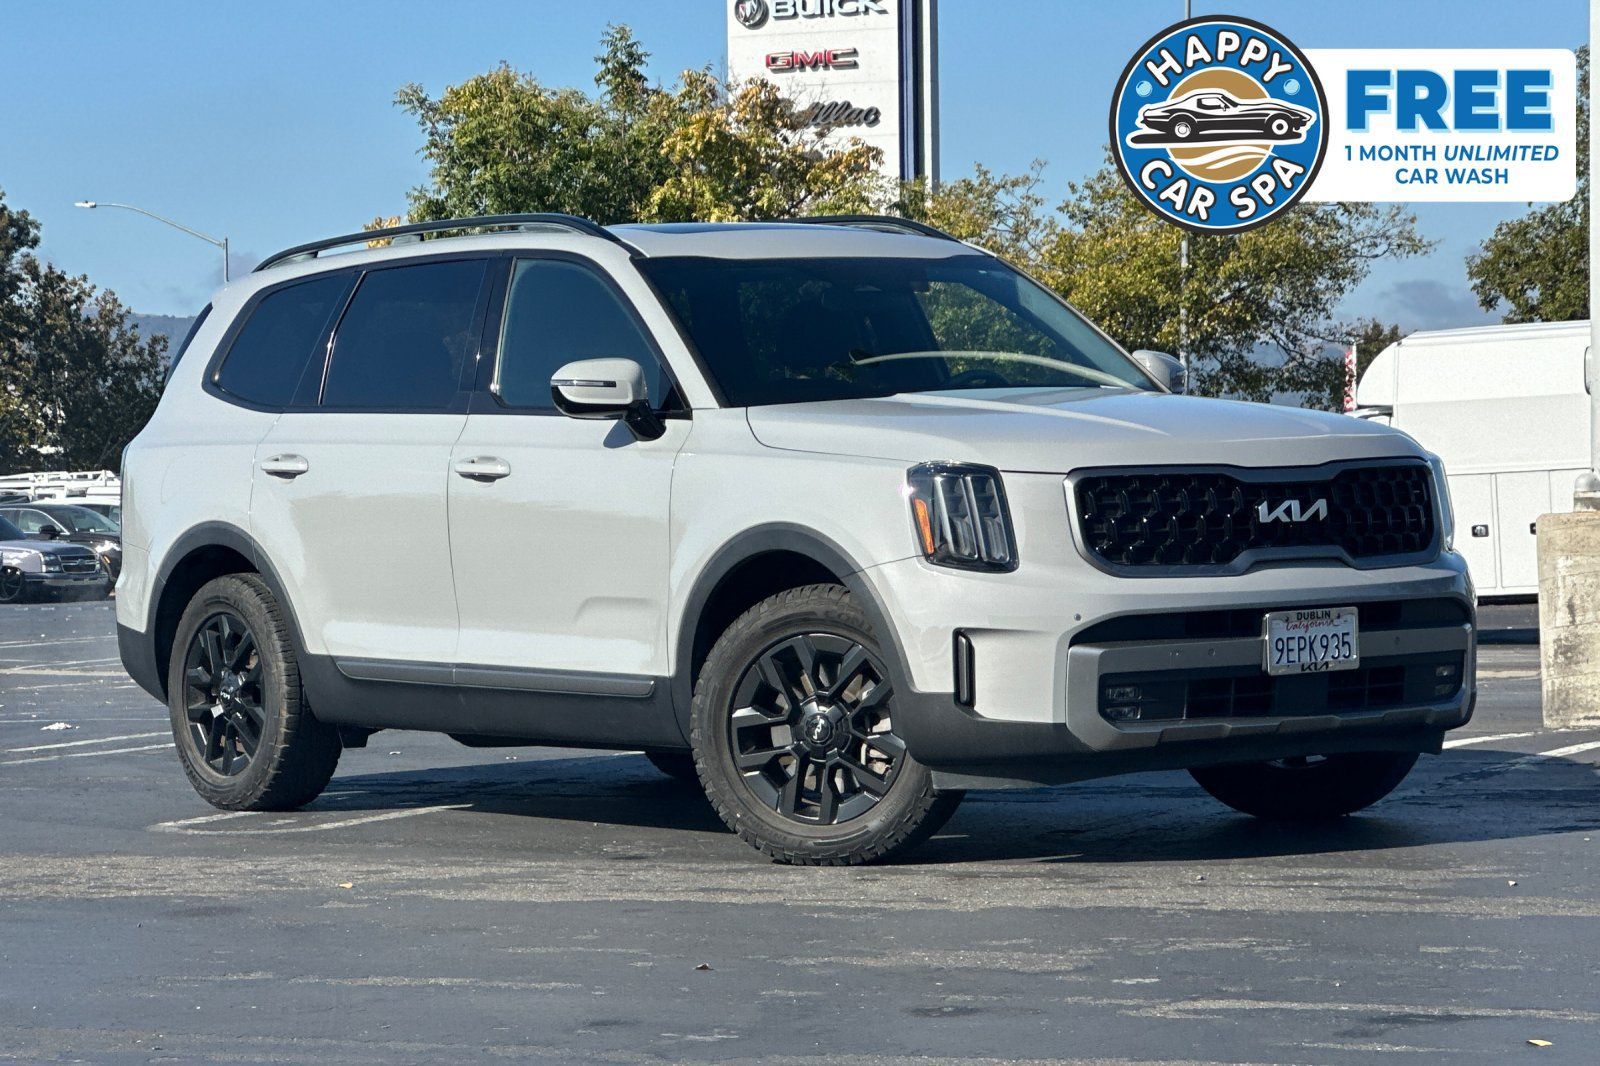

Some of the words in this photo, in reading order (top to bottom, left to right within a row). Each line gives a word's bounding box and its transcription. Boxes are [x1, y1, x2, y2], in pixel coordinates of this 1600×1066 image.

[766, 48, 858, 72] GMC
[1258, 499, 1328, 523] KIA
[1296, 610, 1331, 620] DUBLIN
[1275, 632, 1351, 664] 9EPK935
[1301, 661, 1329, 671] KIA
